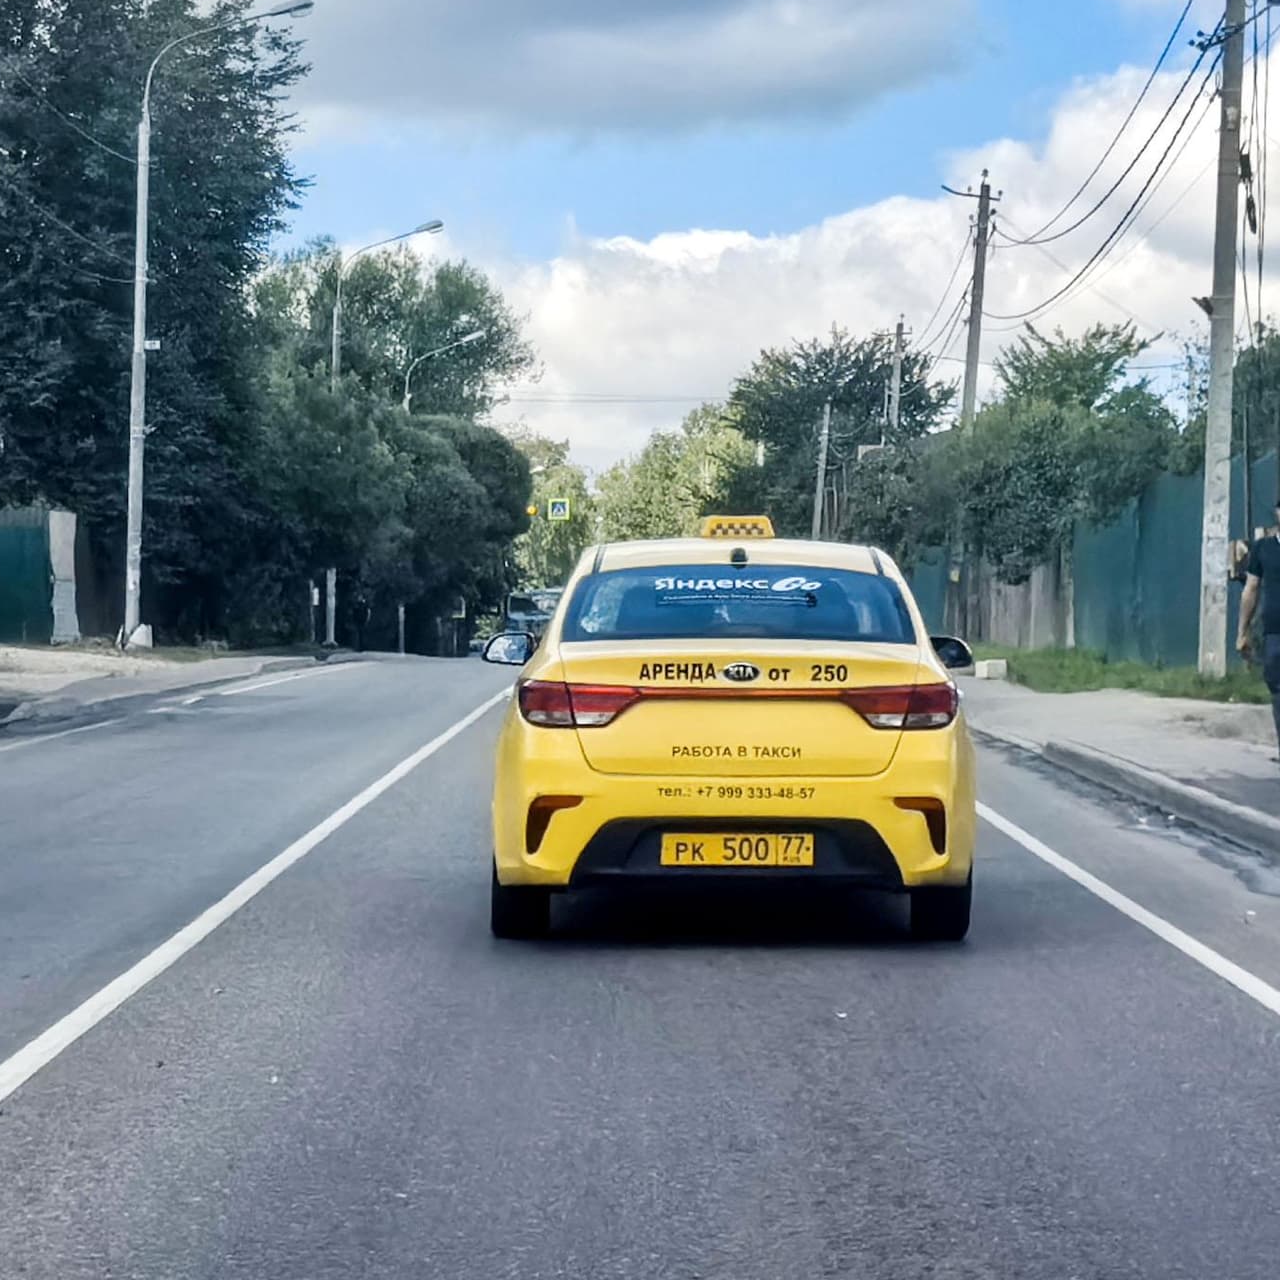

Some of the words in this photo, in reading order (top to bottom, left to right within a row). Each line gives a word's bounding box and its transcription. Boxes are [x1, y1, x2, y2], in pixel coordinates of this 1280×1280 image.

[655, 576, 769, 591] Яндекс
[639, 663, 717, 683] АРЕНДА
[810, 665, 848, 682] 250
[671, 746, 732, 758] РАБОТА
[737, 746, 748, 757] В
[752, 746, 802, 759] ТАКСИ
[696, 787, 713, 798] +7
[717, 787, 743, 799] 999
[747, 788, 815, 800] 333-48-57
[675, 842, 705, 862] РК
[722, 837, 770, 862] 500
[781, 836, 806, 856] 77
